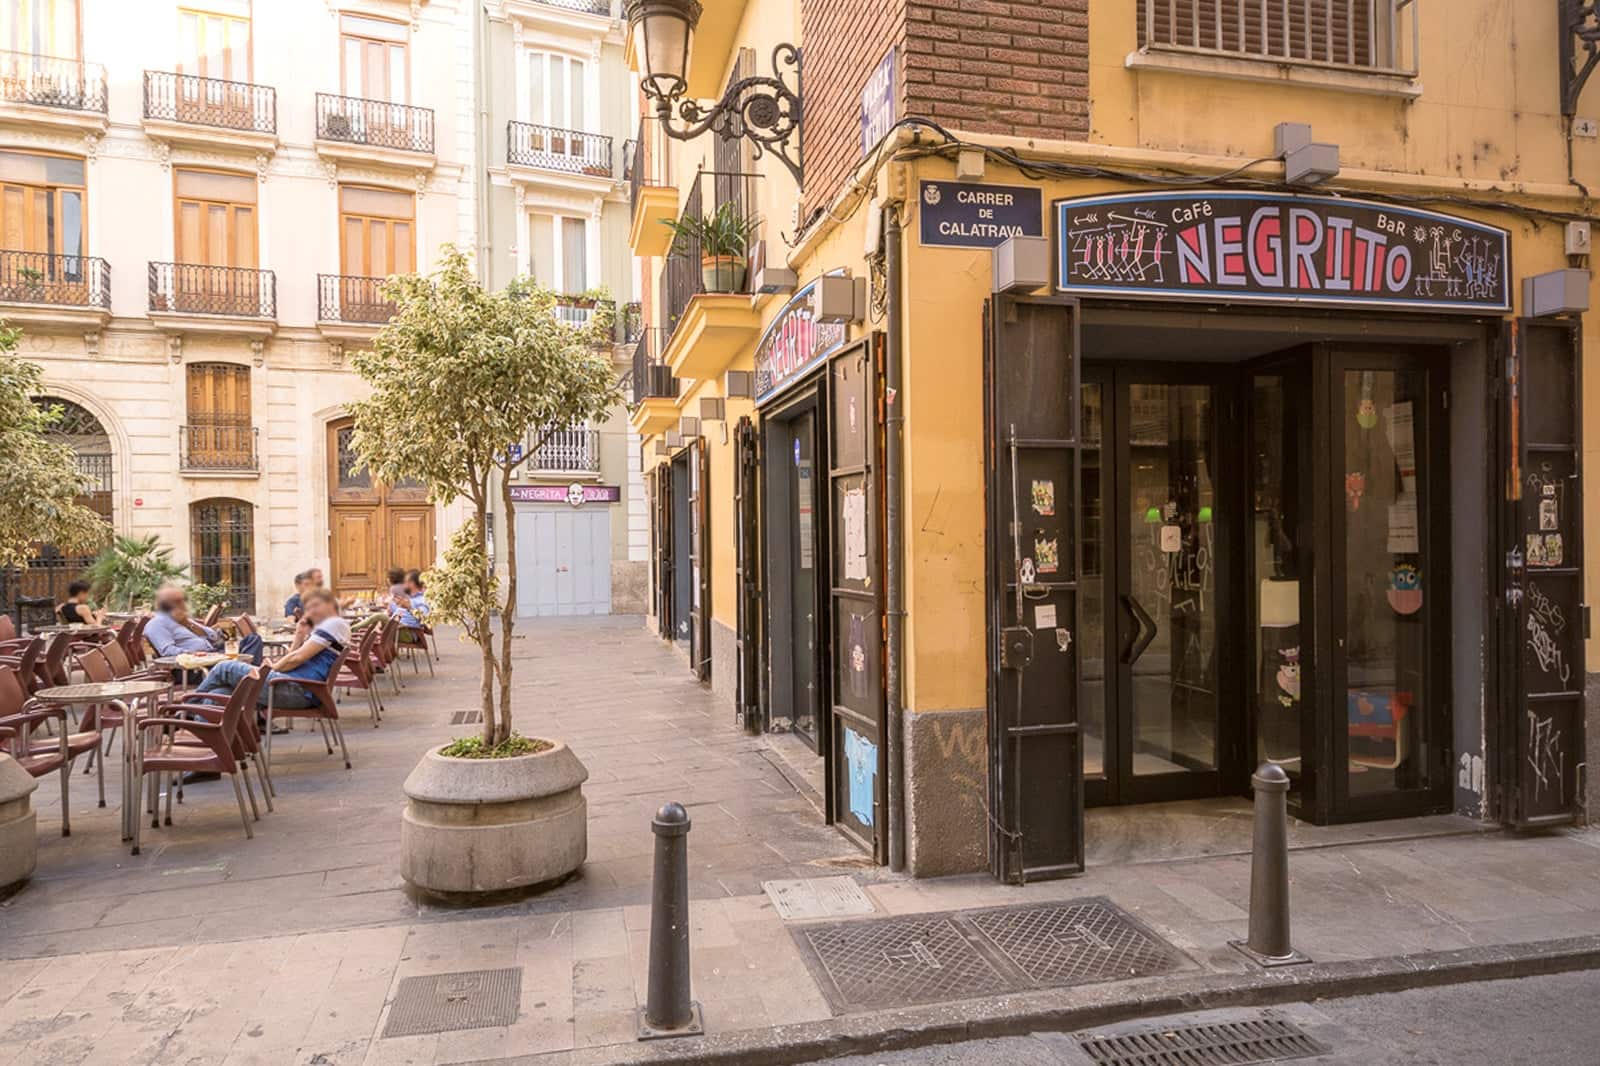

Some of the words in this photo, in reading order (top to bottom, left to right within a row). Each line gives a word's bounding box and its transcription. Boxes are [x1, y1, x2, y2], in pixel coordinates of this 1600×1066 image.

[957, 191, 1014, 206] CARRER
[979, 209, 994, 219] DE
[1171, 200, 1213, 226] CaFé
[939, 221, 1024, 239] CALATRAVA
[1175, 206, 1413, 292] NEGRITO
